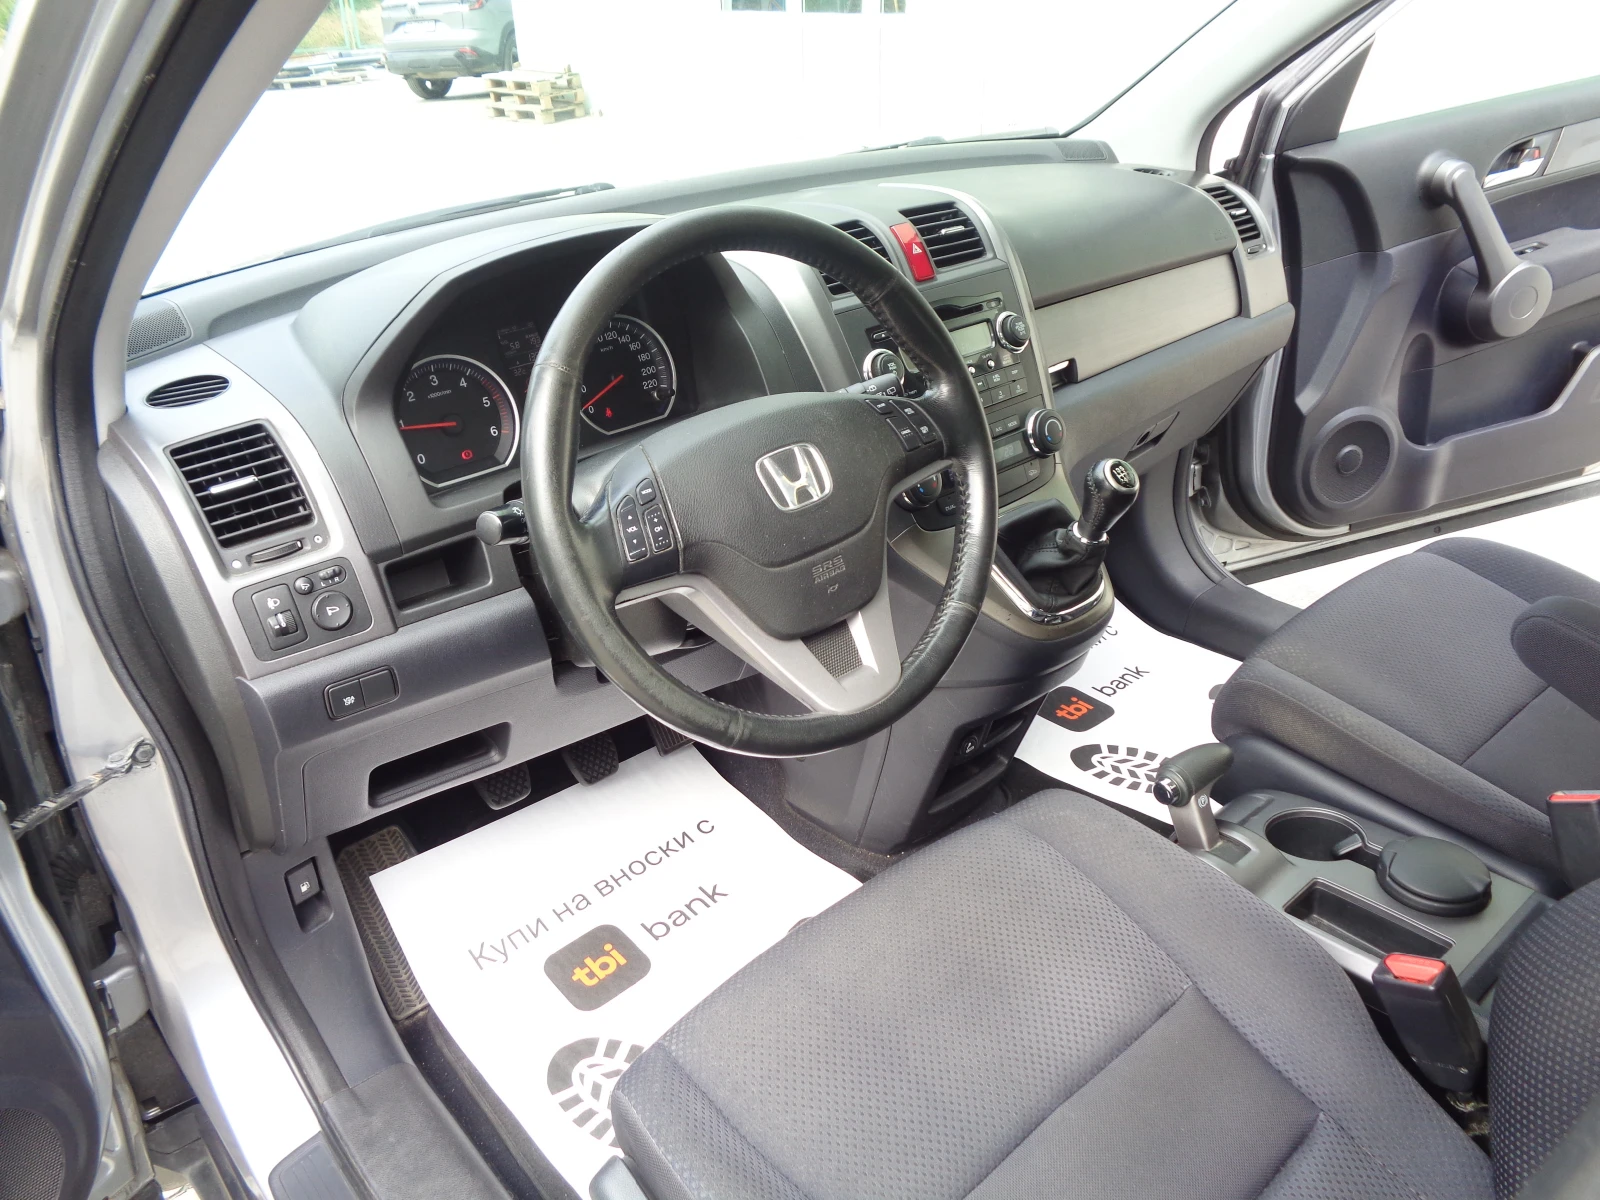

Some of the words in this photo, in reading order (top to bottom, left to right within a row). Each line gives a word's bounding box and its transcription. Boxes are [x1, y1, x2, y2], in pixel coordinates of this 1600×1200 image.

[604, 331, 618, 340] 120
[618, 334, 631, 344] 140
[629, 341, 641, 352] 160
[637, 352, 651, 362] 180
[641, 365, 656, 376] 200
[429, 375, 439, 386] 3
[460, 377, 467, 388] 4
[642, 379, 658, 389] 220
[407, 391, 416, 402] 2
[482, 396, 490, 407] 5
[588, 405, 594, 414] 0
[490, 426, 498, 436] 6
[417, 453, 425, 464] 0
[654, 525, 663, 533] CH
[812, 555, 843, 576] SRS
[815, 564, 846, 584] AIRBAG
[1055, 696, 1095, 720] tbi
[1091, 666, 1150, 697] bank
[468, 917, 549, 970] Купи
[552, 894, 592, 922] на
[593, 831, 695, 898] вноски
[696, 819, 715, 834] с
[571, 943, 627, 987] tbi
[640, 884, 729, 940] bank
